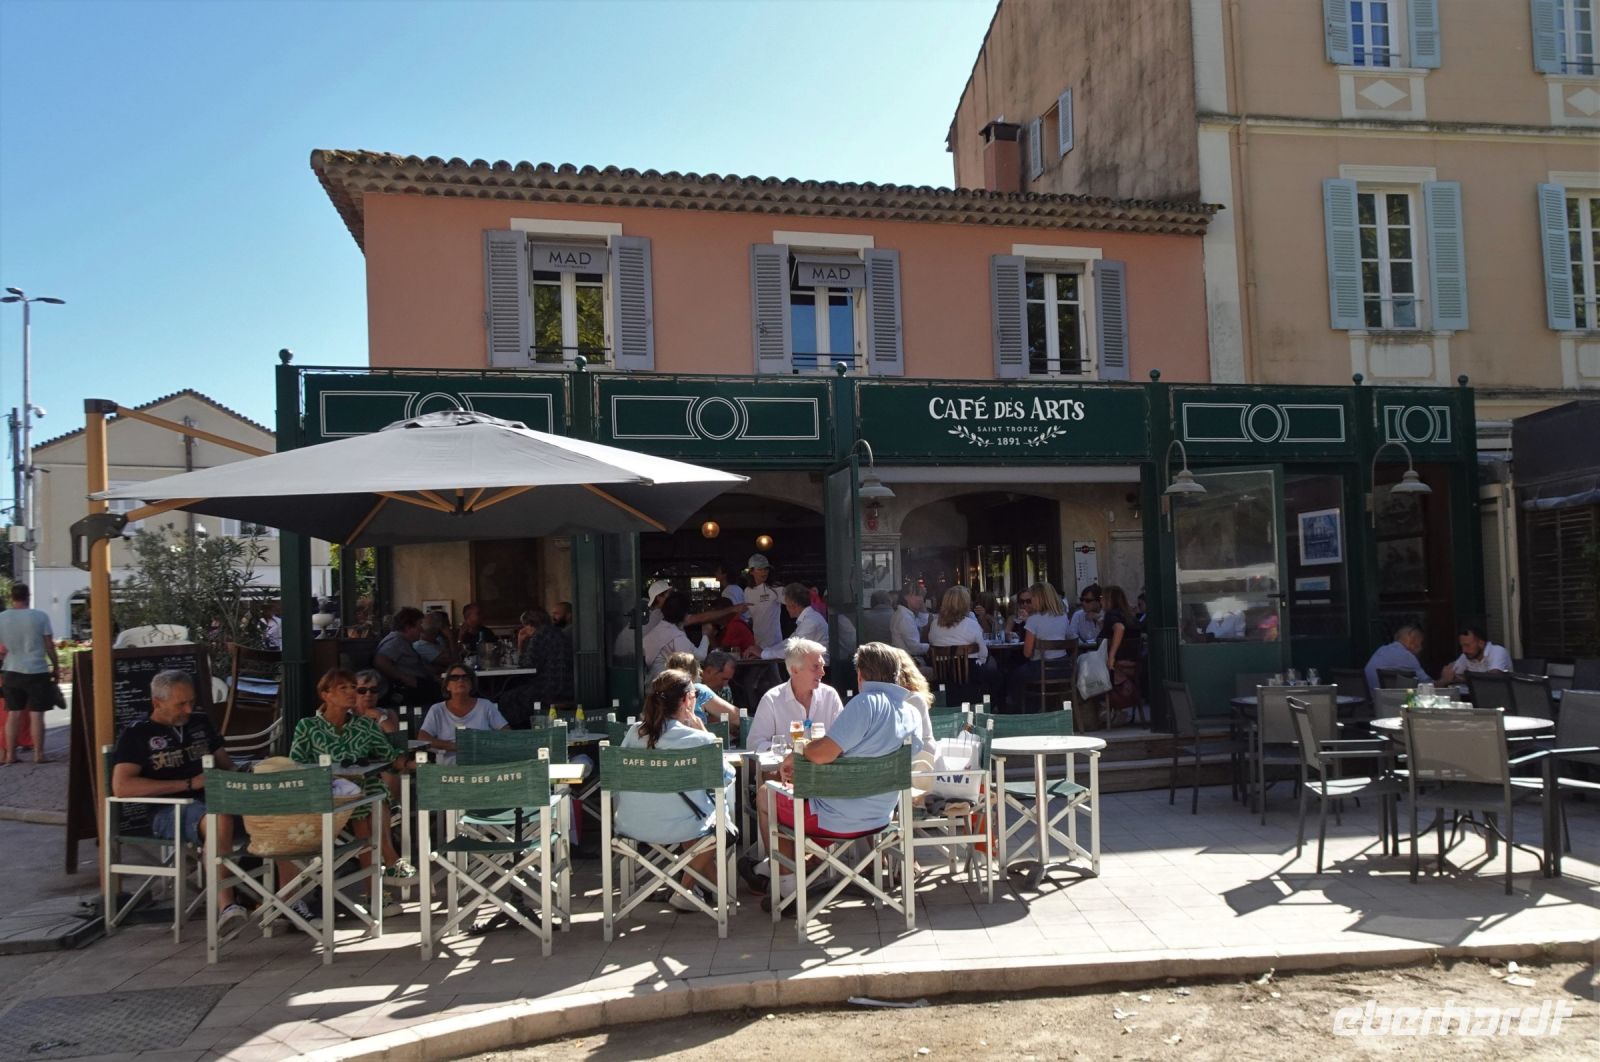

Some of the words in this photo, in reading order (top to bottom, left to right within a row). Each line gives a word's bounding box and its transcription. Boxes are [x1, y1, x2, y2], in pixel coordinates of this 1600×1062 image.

[548, 251, 592, 265] MAD
[812, 267, 851, 280] MAD
[928, 396, 989, 420] CAFÉ
[1030, 396, 1085, 421] ARTS
[997, 437, 1021, 446] 1891
[623, 758, 645, 767] CAFE
[650, 759, 668, 767] DES
[673, 757, 697, 767] ARTS
[441, 775, 465, 784] CAFE
[471, 775, 490, 784] DES
[496, 772, 522, 782] ARTS
[226, 780, 247, 790] CAFE
[278, 780, 304, 789] ARTS
